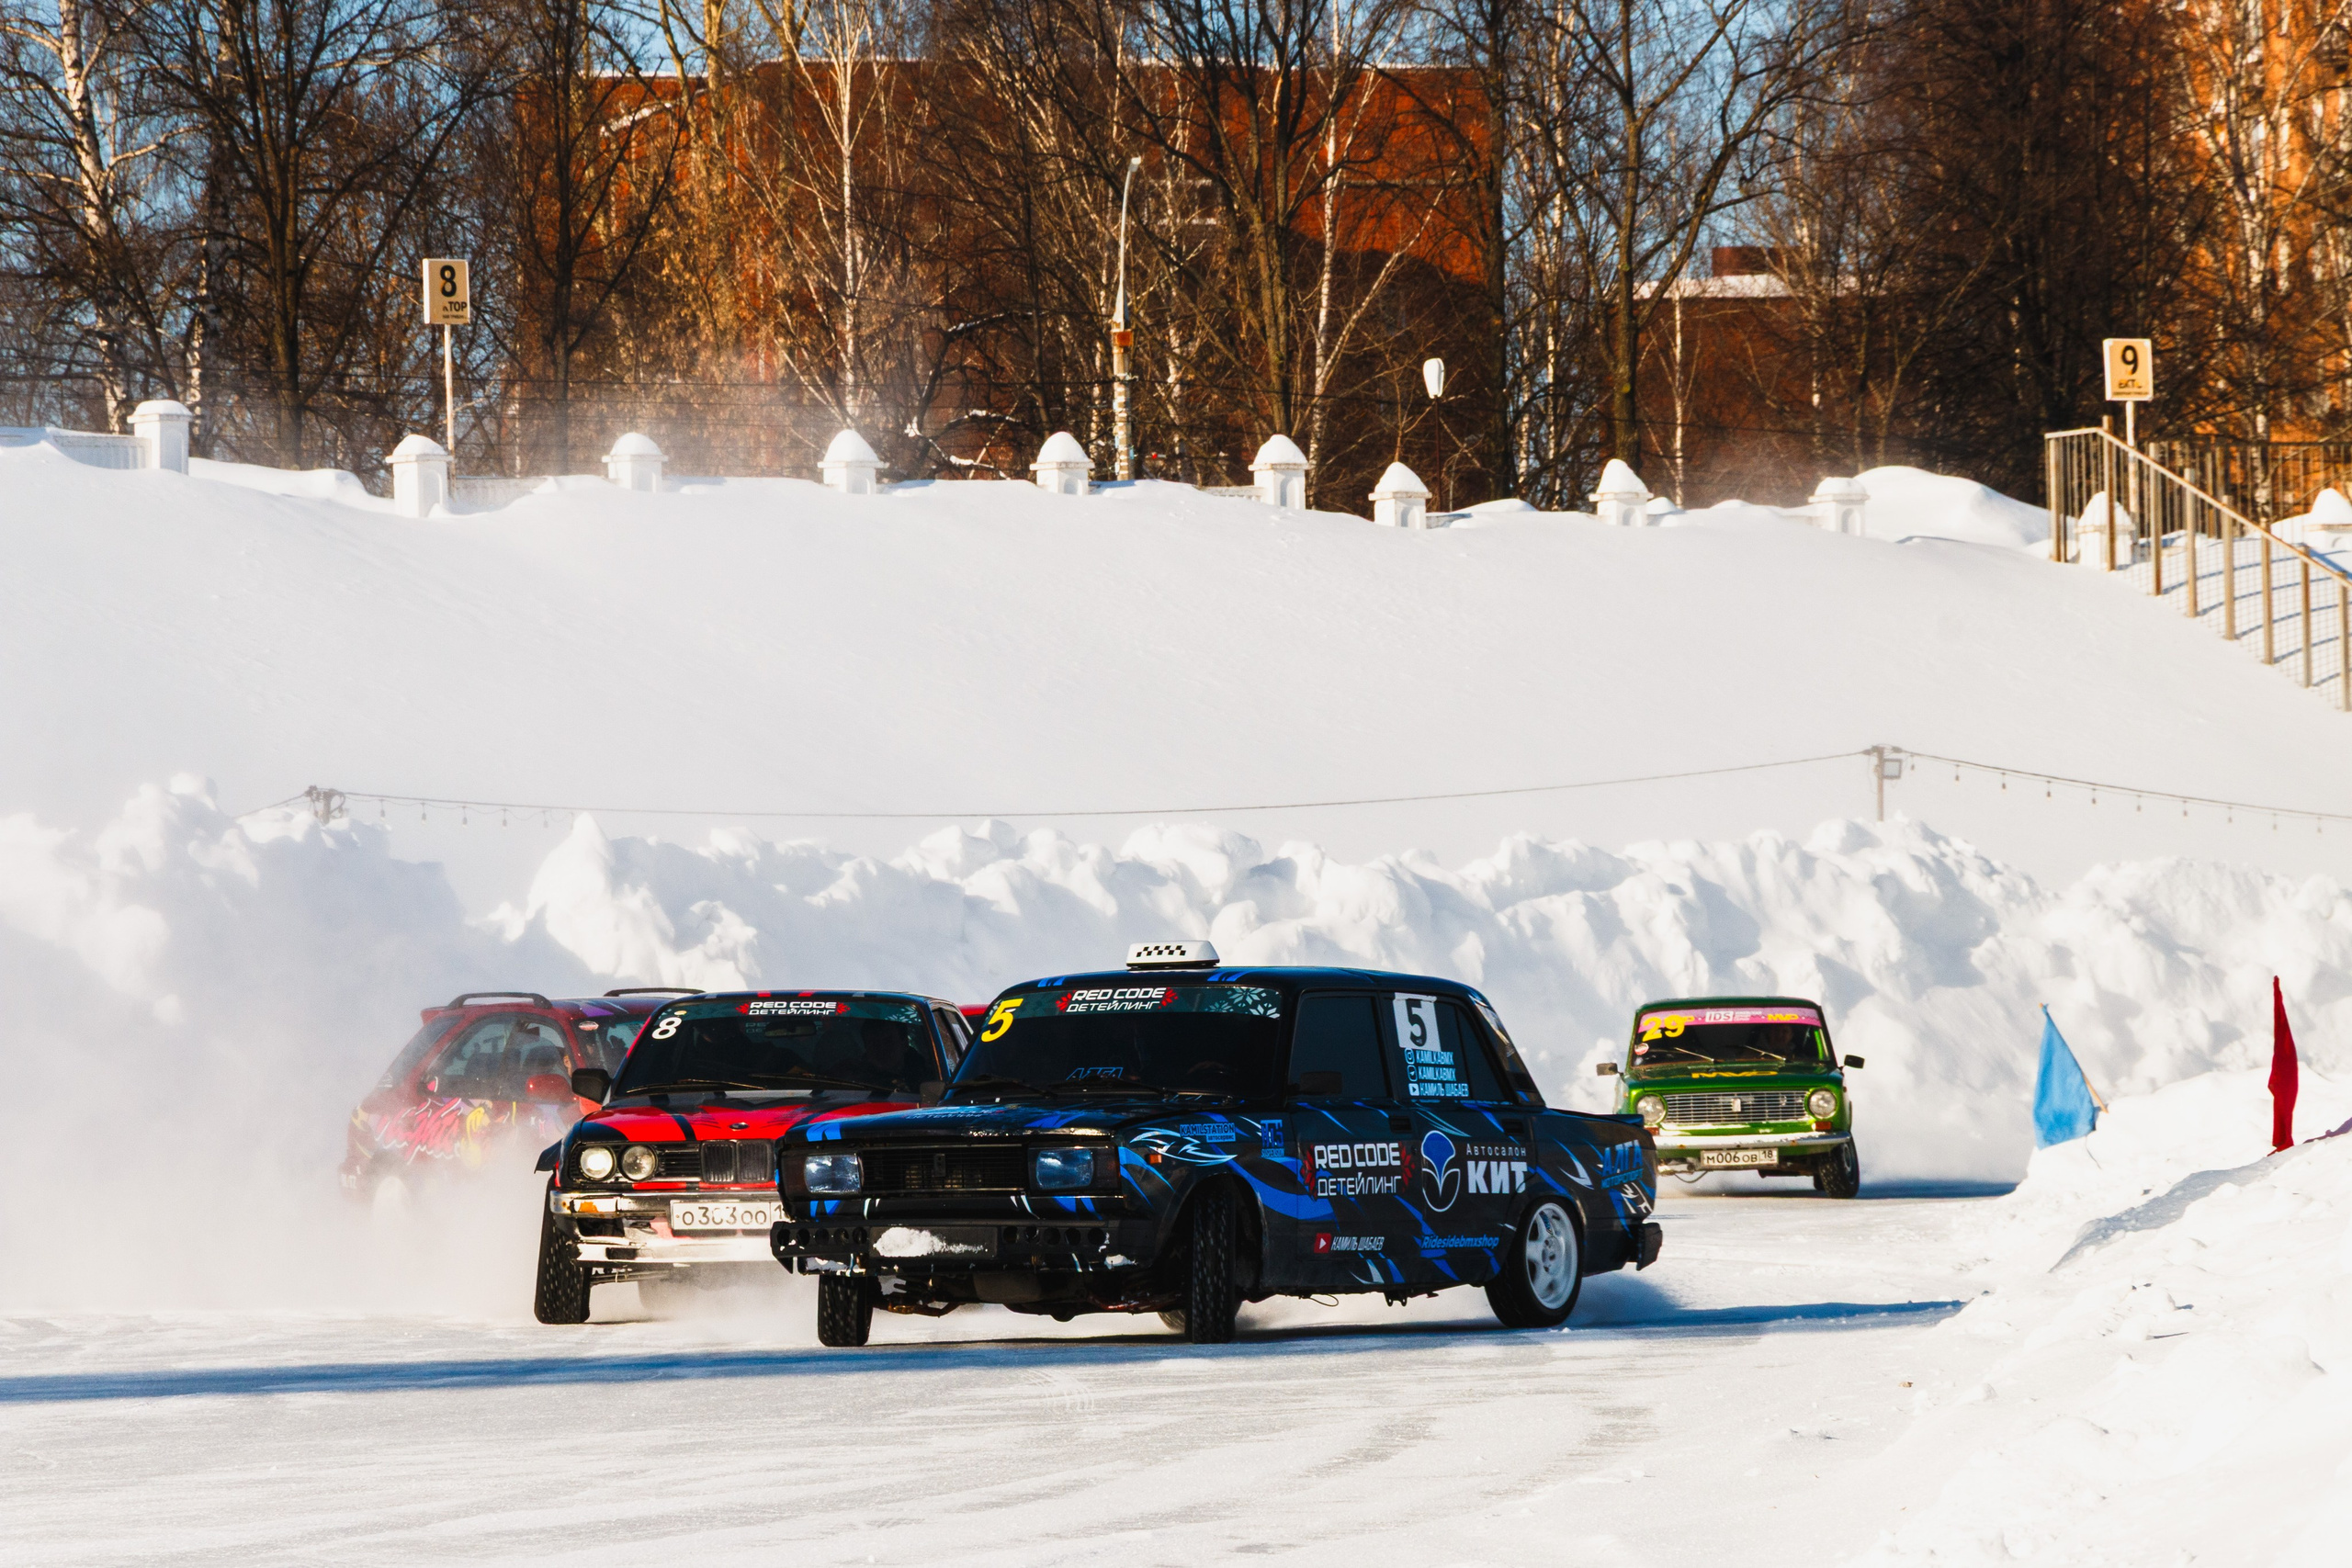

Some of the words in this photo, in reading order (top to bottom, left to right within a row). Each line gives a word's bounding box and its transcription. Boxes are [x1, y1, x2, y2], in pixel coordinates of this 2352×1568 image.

[440, 265, 457, 298] 8
[2121, 344, 2138, 375] 9
[1071, 989, 1112, 1001] RED
[1114, 987, 1167, 999] CODE
[789, 1001, 837, 1010] CODE
[1066, 1000, 1160, 1013] ДЕТЕЙЛИНГ
[980, 998, 1023, 1043] 5
[1405, 998, 1427, 1047] 5
[1709, 1012, 1731, 1021] IDS
[651, 1016, 683, 1040] 8
[1642, 1014, 1686, 1043] 29
[1180, 1122, 1236, 1136] KAMILSTATION
[1314, 1145, 1352, 1169] RED
[1353, 1143, 1401, 1167] CODE
[1466, 1143, 1527, 1156] Автосалон
[1762, 1149, 1774, 1159] 18
[1317, 1173, 1402, 1197] ДЕТЕЙЛИНГ
[1467, 1160, 1528, 1194] КИТ
[1330, 1236, 1359, 1251] КАМИЛЬ
[1358, 1236, 1385, 1251] ШАБАЕВ
[1422, 1235, 1499, 1250] Ridesidebmxshop
